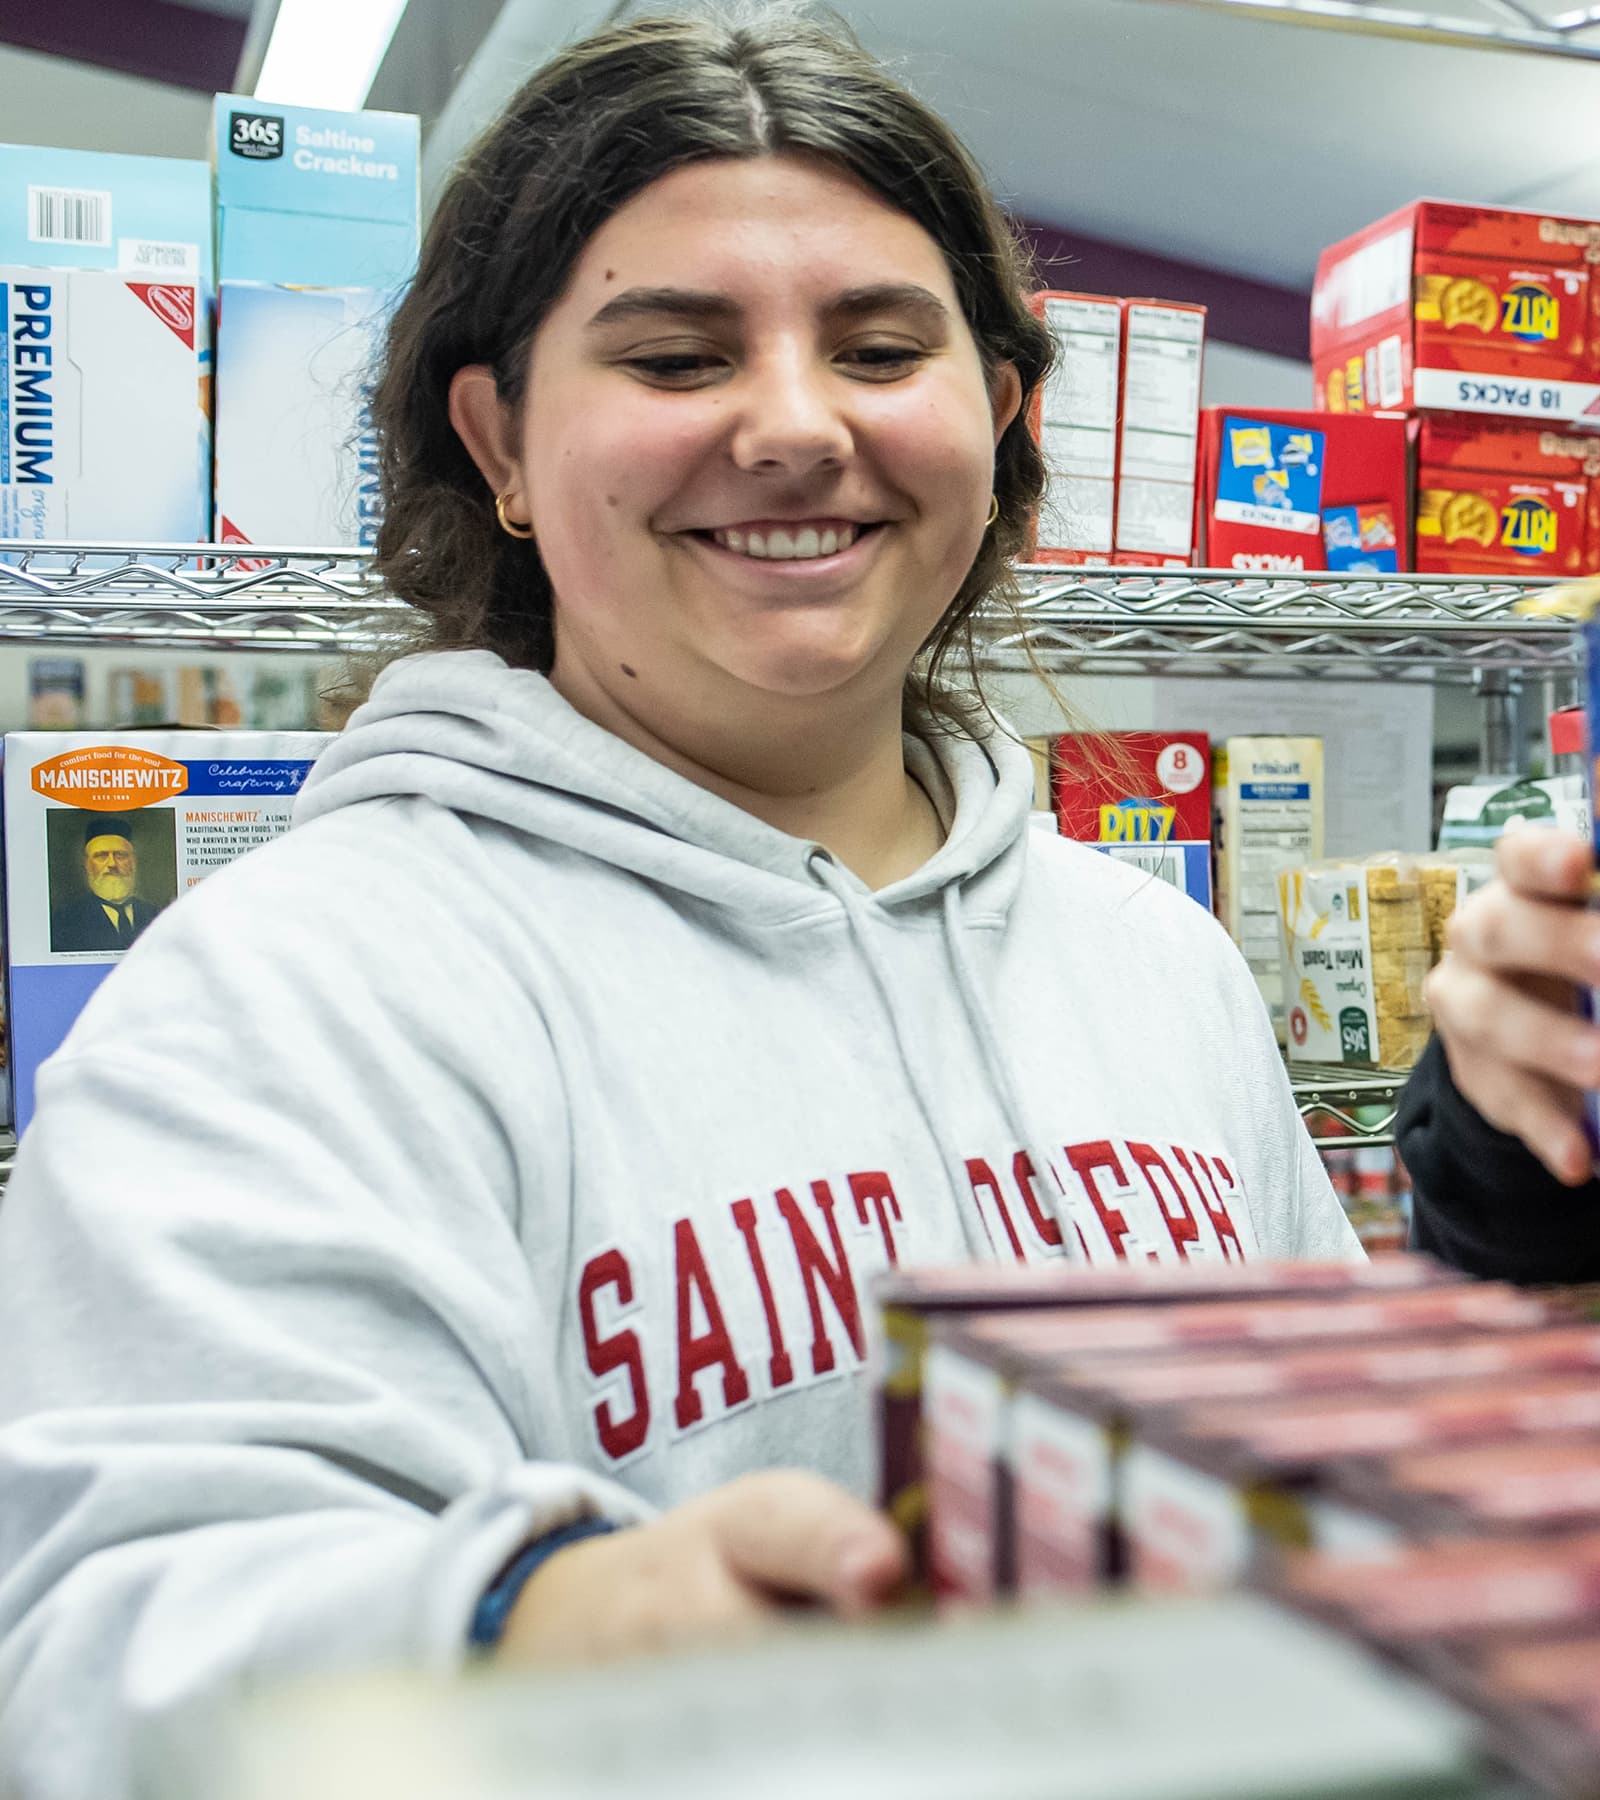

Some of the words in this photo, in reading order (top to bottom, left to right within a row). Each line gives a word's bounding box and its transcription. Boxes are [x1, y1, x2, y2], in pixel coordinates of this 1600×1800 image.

[233, 117, 281, 146] 365
[295, 125, 376, 154] Saltine
[294, 149, 399, 180] Crackers
[1501, 293, 1560, 340] RITZ
[13, 284, 54, 485] PREMIUM
[1458, 381, 1531, 407] PACKS
[1541, 387, 1561, 409] 18
[21, 488, 50, 540] origina
[1501, 506, 1559, 554] RITZ
[59, 753, 92, 768] comfort
[93, 751, 113, 759] food
[114, 751, 127, 759] for
[129, 753, 143, 763] the
[1173, 749, 1187, 770] 8
[39, 768, 183, 790] MANISCHEWITZ
[208, 764, 300, 785] Celebrating
[218, 778, 286, 791] crafting
[271, 814, 288, 823] LONG
[185, 825, 226, 834] TRADITIONAL
[227, 825, 250, 834] JEWISH
[274, 825, 286, 833] THE
[186, 836, 201, 844] WHO
[203, 836, 229, 844] ARRIVED
[230, 836, 238, 844] IN
[239, 836, 250, 844] THE
[251, 836, 264, 844] USA
[186, 847, 198, 855] THE
[200, 847, 236, 855] TRADITIONS
[186, 858, 199, 866] FOR
[1302, 949, 1334, 970] Toast
[1336, 949, 1364, 969] Mini
[579, 1171, 904, 1460] SAINT
